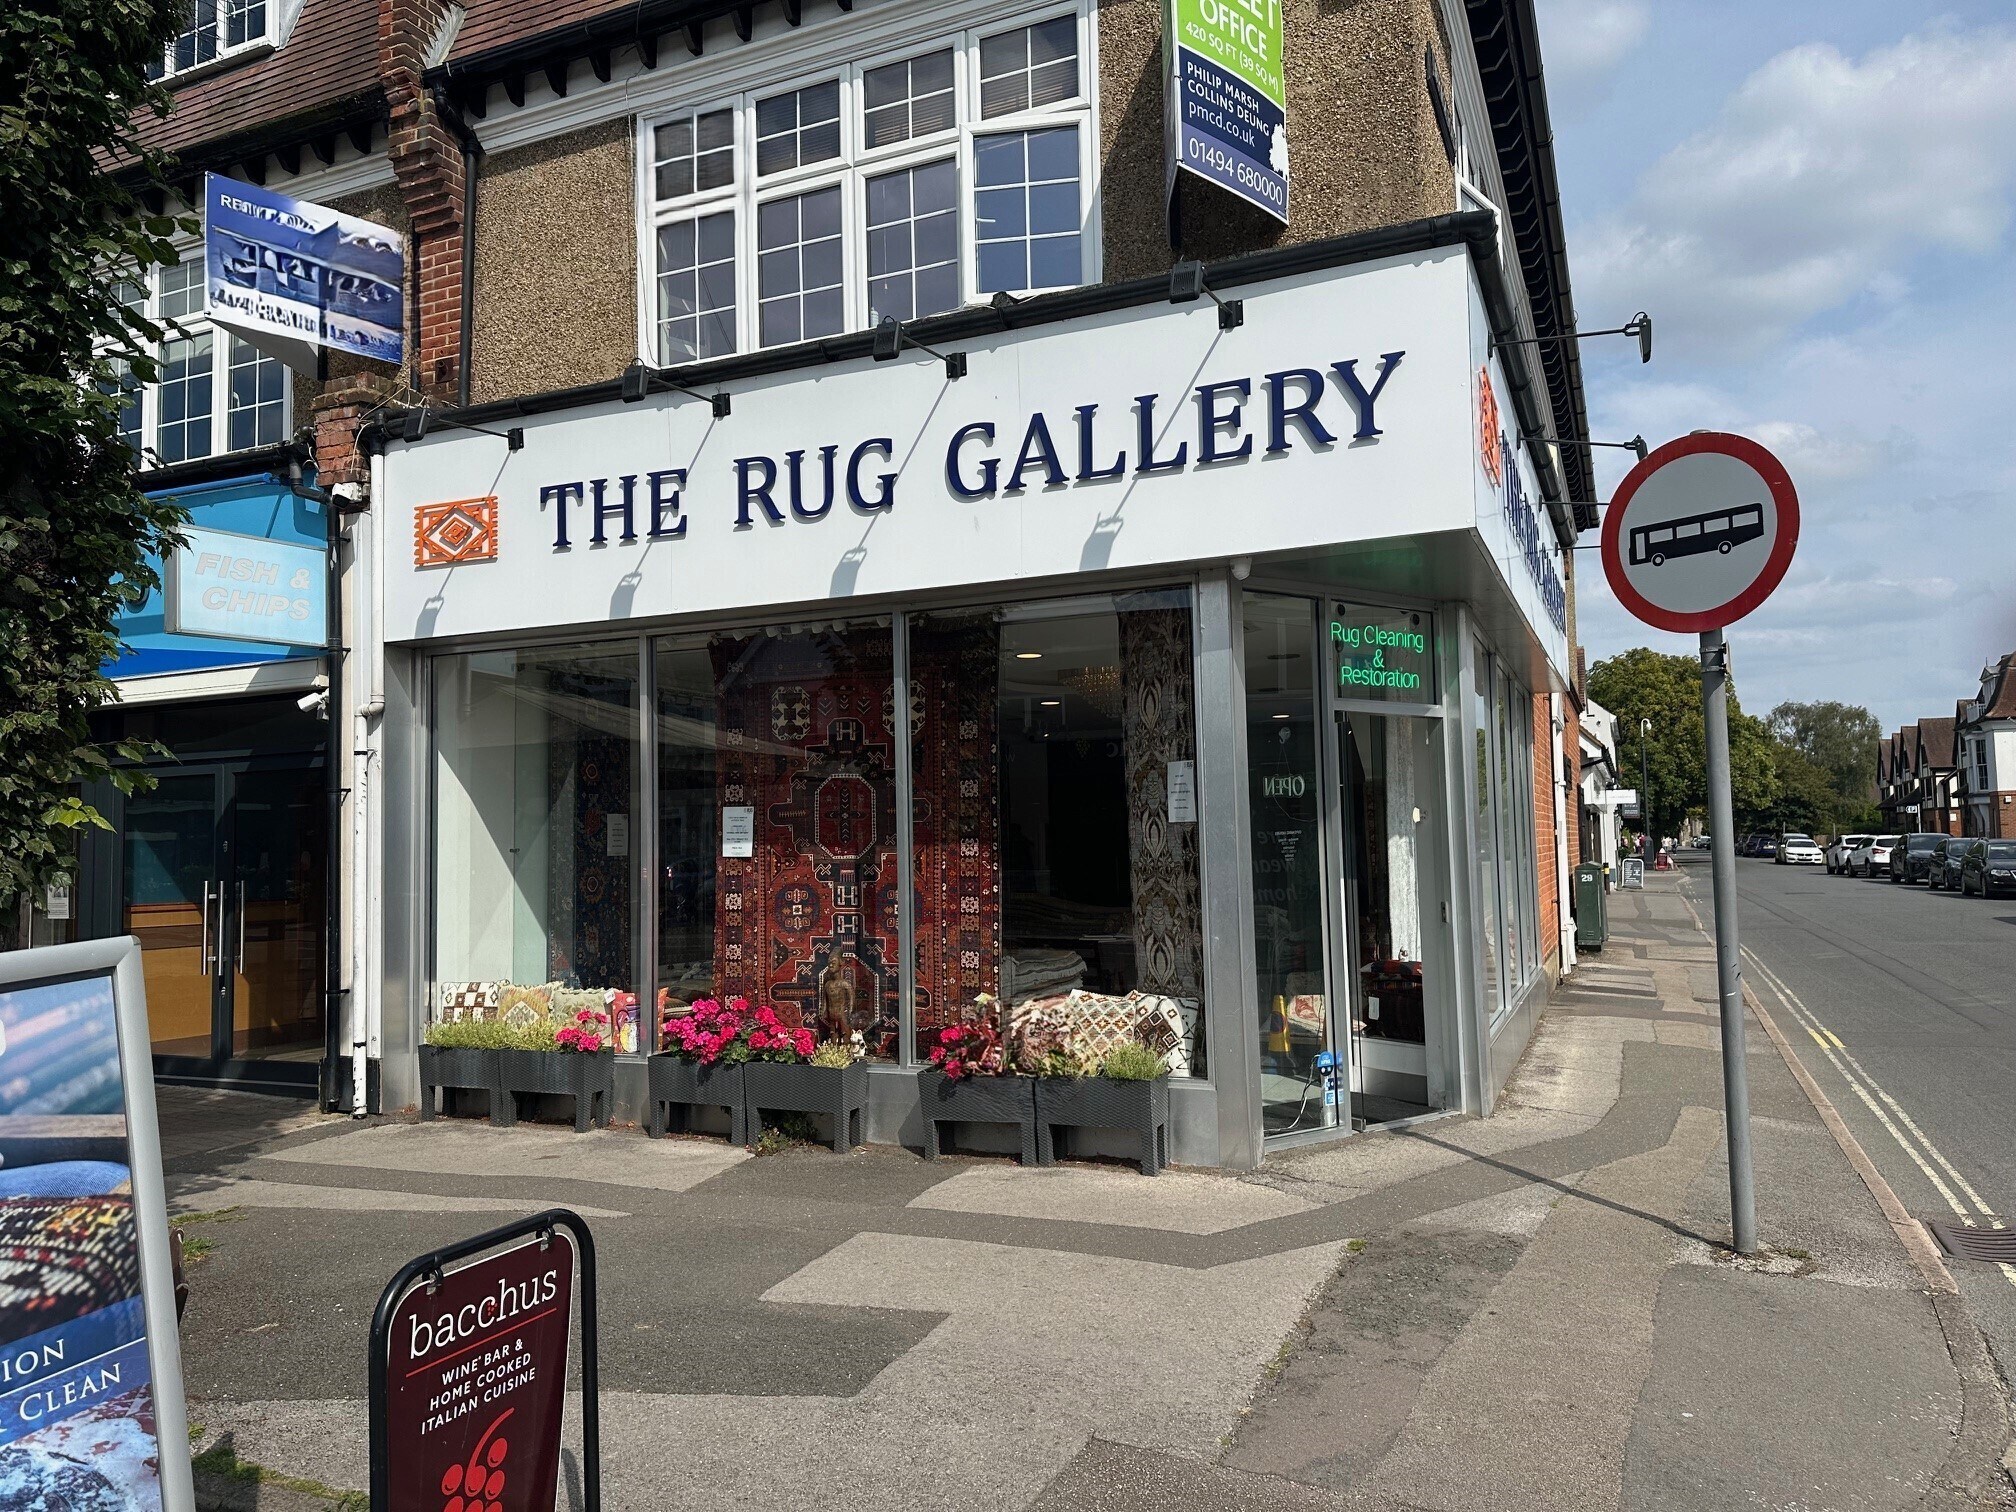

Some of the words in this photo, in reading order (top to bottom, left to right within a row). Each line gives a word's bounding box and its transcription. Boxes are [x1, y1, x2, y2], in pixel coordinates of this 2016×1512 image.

[1185, 21, 1206, 42] 420
[1208, 33, 1223, 55] SQ
[1226, 43, 1237, 60] FT
[1240, 50, 1254, 71] (39
[1255, 63, 1267, 84] SQ
[1268, 73, 1279, 95] M)
[1200, 0, 1268, 62] OFFICE
[1187, 61, 1221, 89] PHILIP
[1225, 82, 1259, 113] MARSH
[1187, 79, 1234, 113] COLLINS
[1237, 105, 1270, 136] DEUNG
[1189, 102, 1255, 147] pmcd.co.uk
[1189, 137, 1234, 177] 01494
[1237, 162, 1283, 205] 680000
[540, 468, 688, 547] THE
[733, 438, 898, 525] RUG
[946, 350, 1406, 497] GALLERY
[195, 552, 280, 586] FISH
[289, 568, 310, 590] &
[202, 586, 311, 620] CHIPS
[1331, 622, 1360, 648] Rug
[1364, 625, 1424, 654] Cleaning
[1373, 649, 1384, 668] &
[1341, 666, 1420, 688] Restoration
[1581, 874, 1593, 882] 29
[409, 1270, 558, 1360] bacchus
[429, 1381, 471, 1411] HOME
[476, 1352, 532, 1388] COOKED
[442, 1357, 479, 1386] WINE
[484, 1344, 510, 1367] BAR
[514, 1338, 523, 1351] &
[19, 1363, 121, 1422] CLEAN
[421, 1396, 479, 1435] ITALIAN
[483, 1367, 537, 1403] CUISINE
